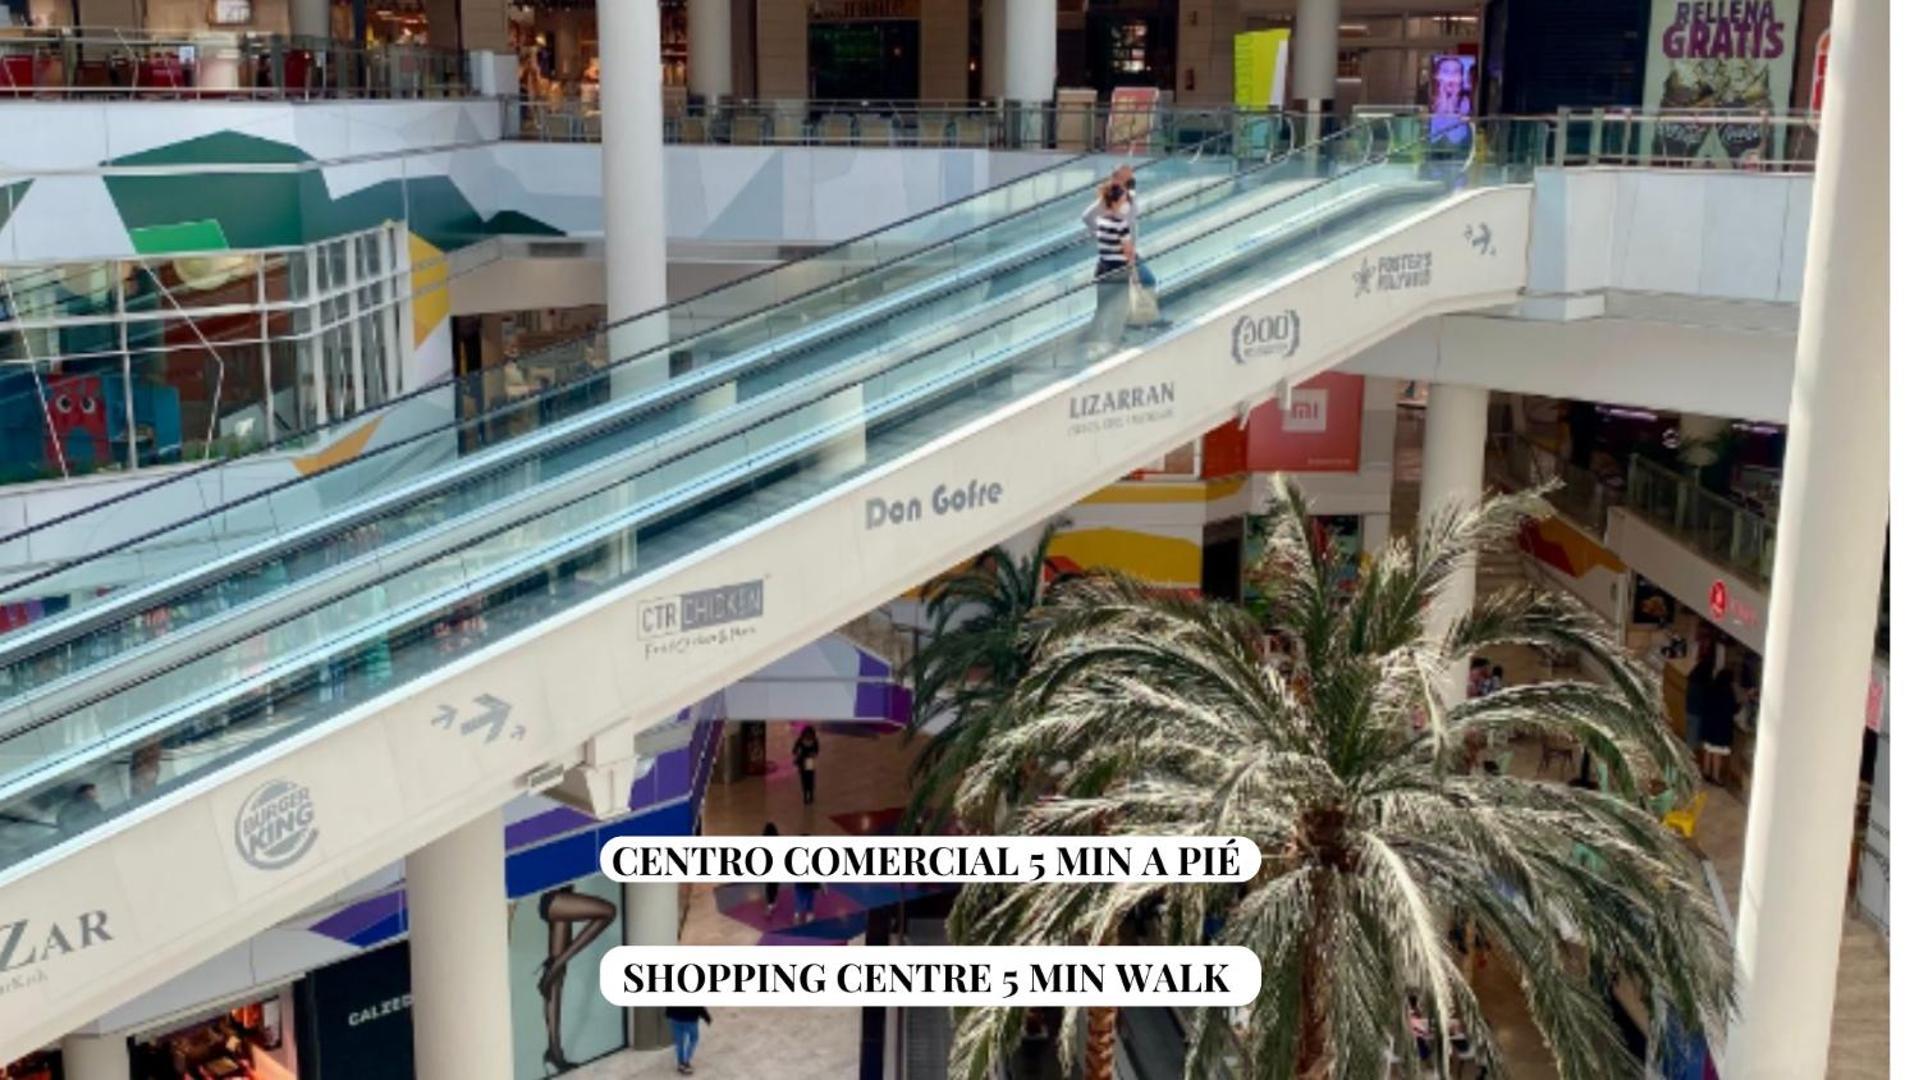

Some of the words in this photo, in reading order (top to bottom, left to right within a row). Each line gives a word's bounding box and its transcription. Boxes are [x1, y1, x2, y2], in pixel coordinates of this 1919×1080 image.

[1674, 0, 1774, 25] RELLENA
[1662, 19, 1784, 59] GRATIS
[1069, 382, 1175, 419] LIZARRAN
[931, 479, 1003, 516] Gofre
[642, 603, 676, 633] CTR
[683, 587, 762, 625] CHICKEN
[243, 787, 310, 837] BURGER
[249, 801, 315, 857] KING
